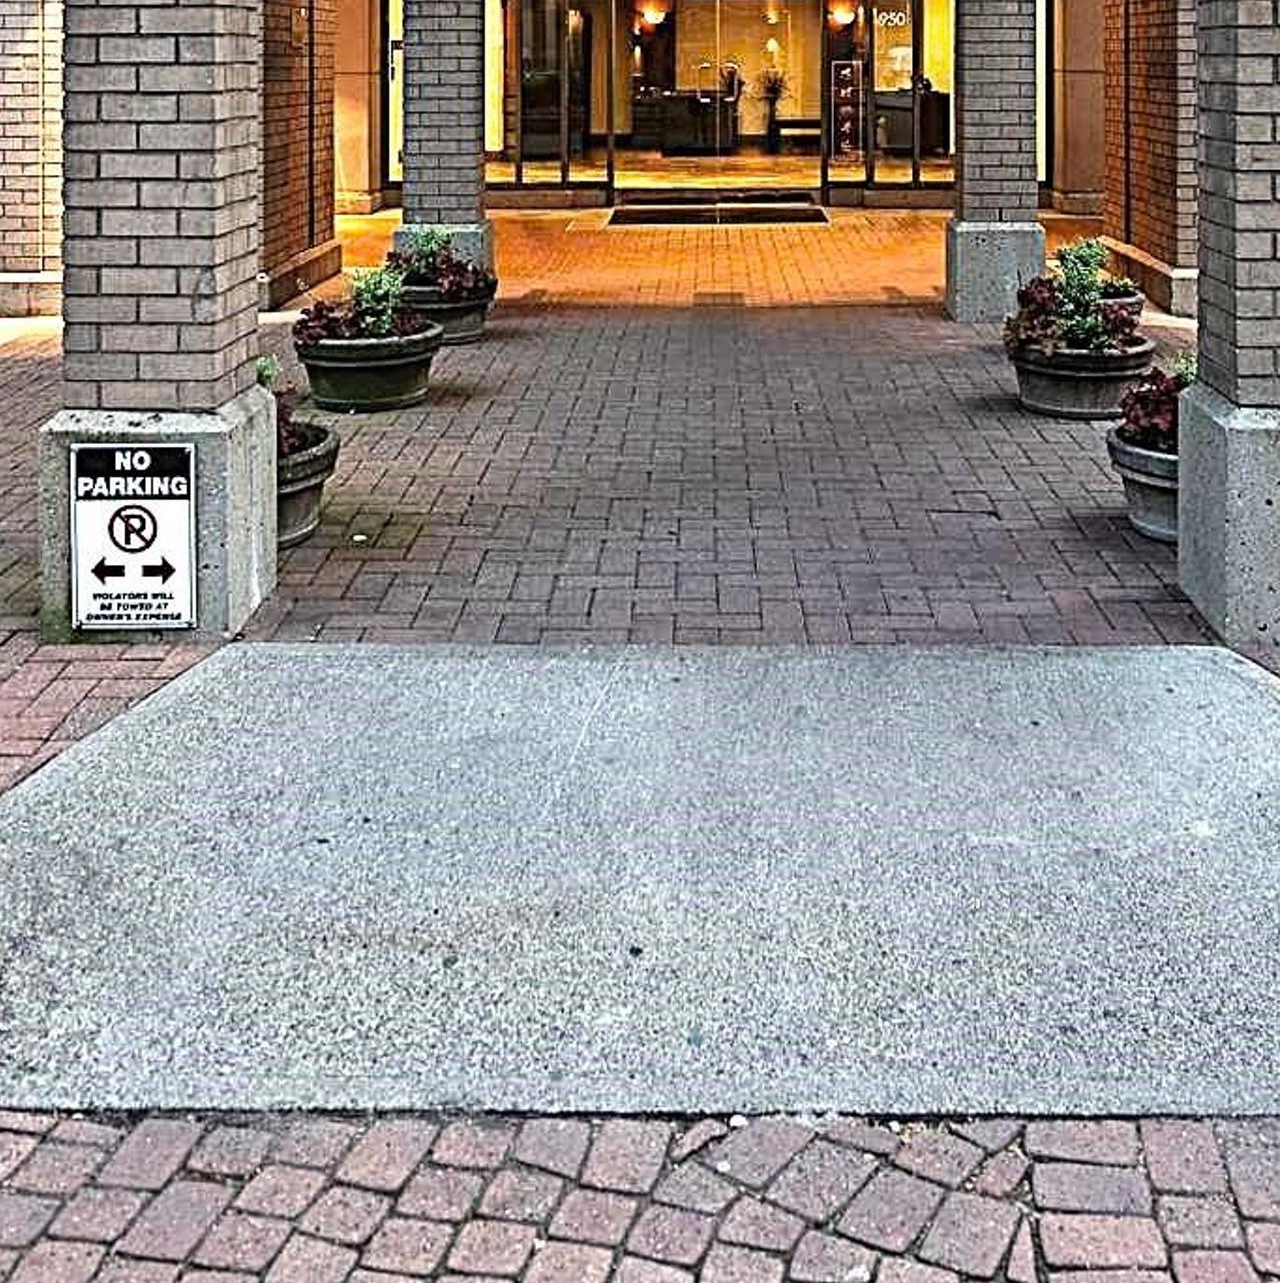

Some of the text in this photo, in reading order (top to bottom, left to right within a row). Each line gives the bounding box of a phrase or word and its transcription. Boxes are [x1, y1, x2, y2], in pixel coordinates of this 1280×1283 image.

[115, 450, 151, 471] NO
[77, 475, 188, 497] PARKING
[156, 602, 169, 610] AT
